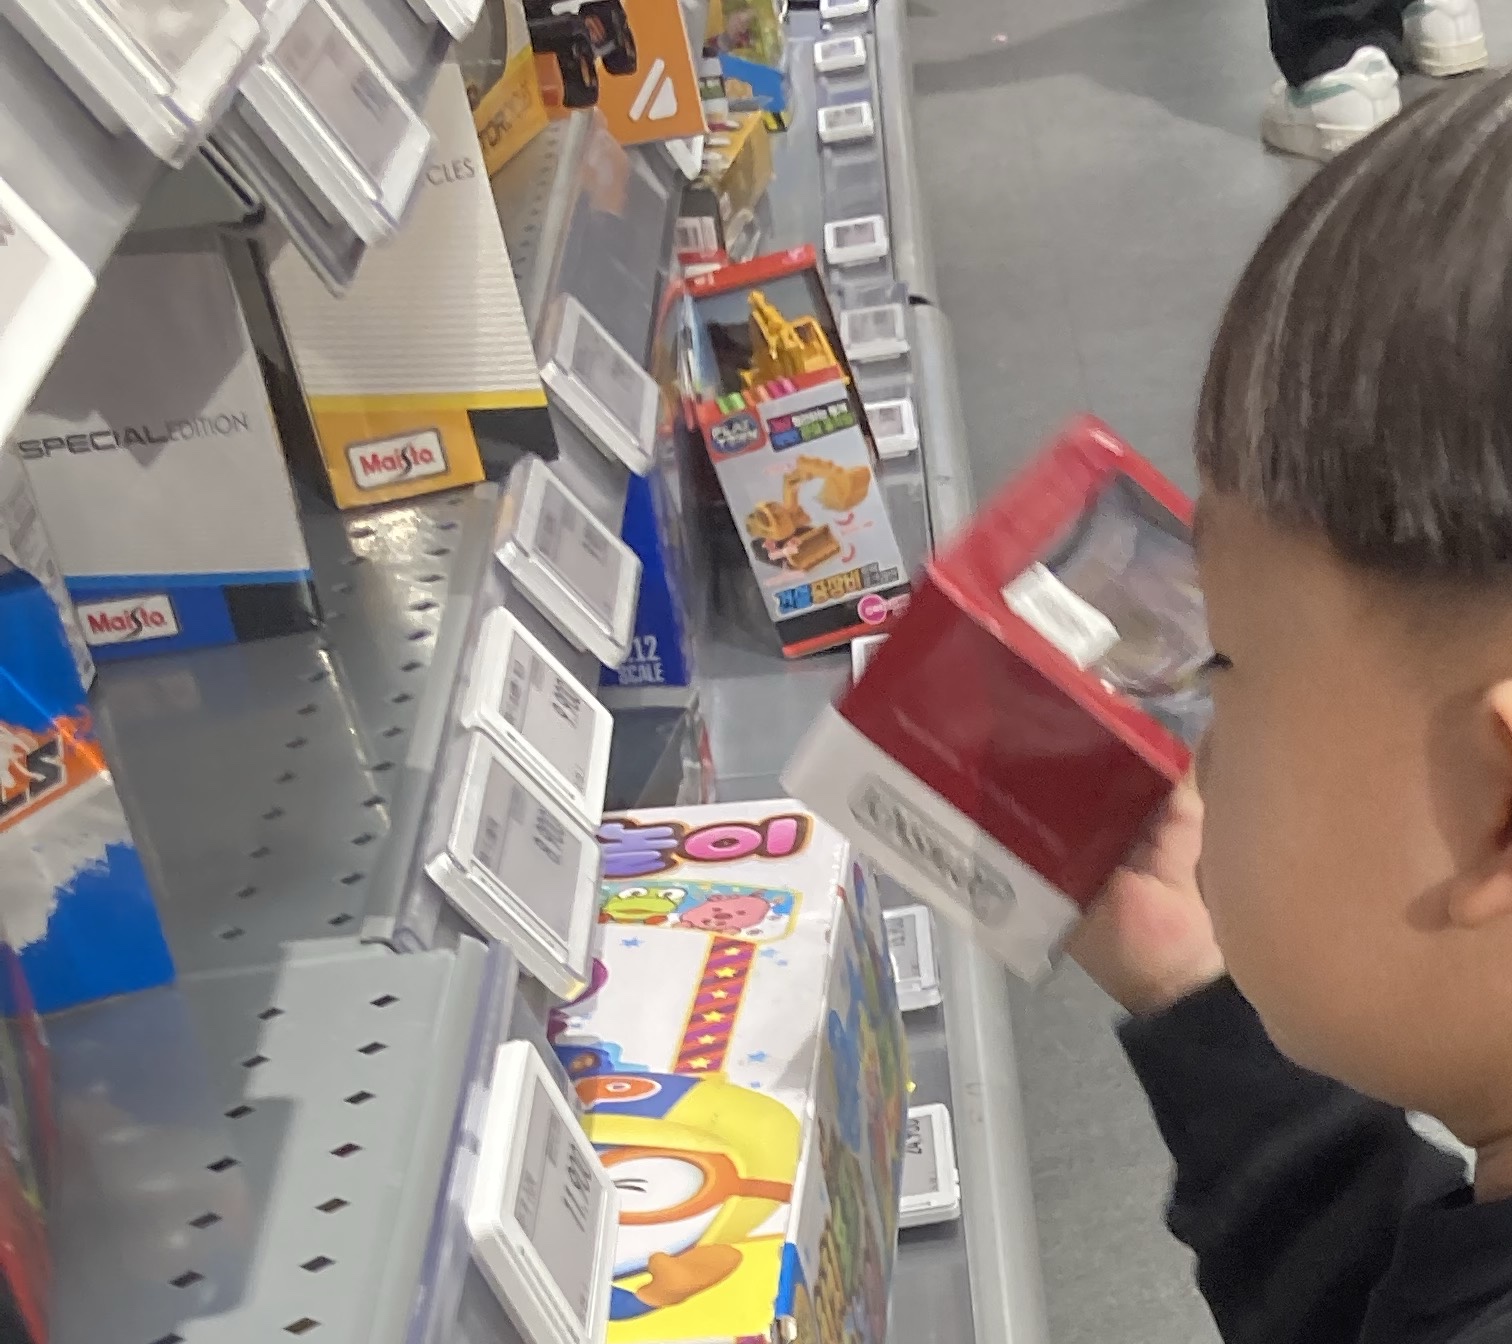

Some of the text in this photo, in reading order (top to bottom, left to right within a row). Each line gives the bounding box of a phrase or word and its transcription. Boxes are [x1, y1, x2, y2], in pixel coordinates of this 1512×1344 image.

[424, 156, 475, 186] CLES
[359, 442, 434, 478] Maisto
[87, 603, 167, 640] Maisto
[618, 662, 665, 684] SCALE
